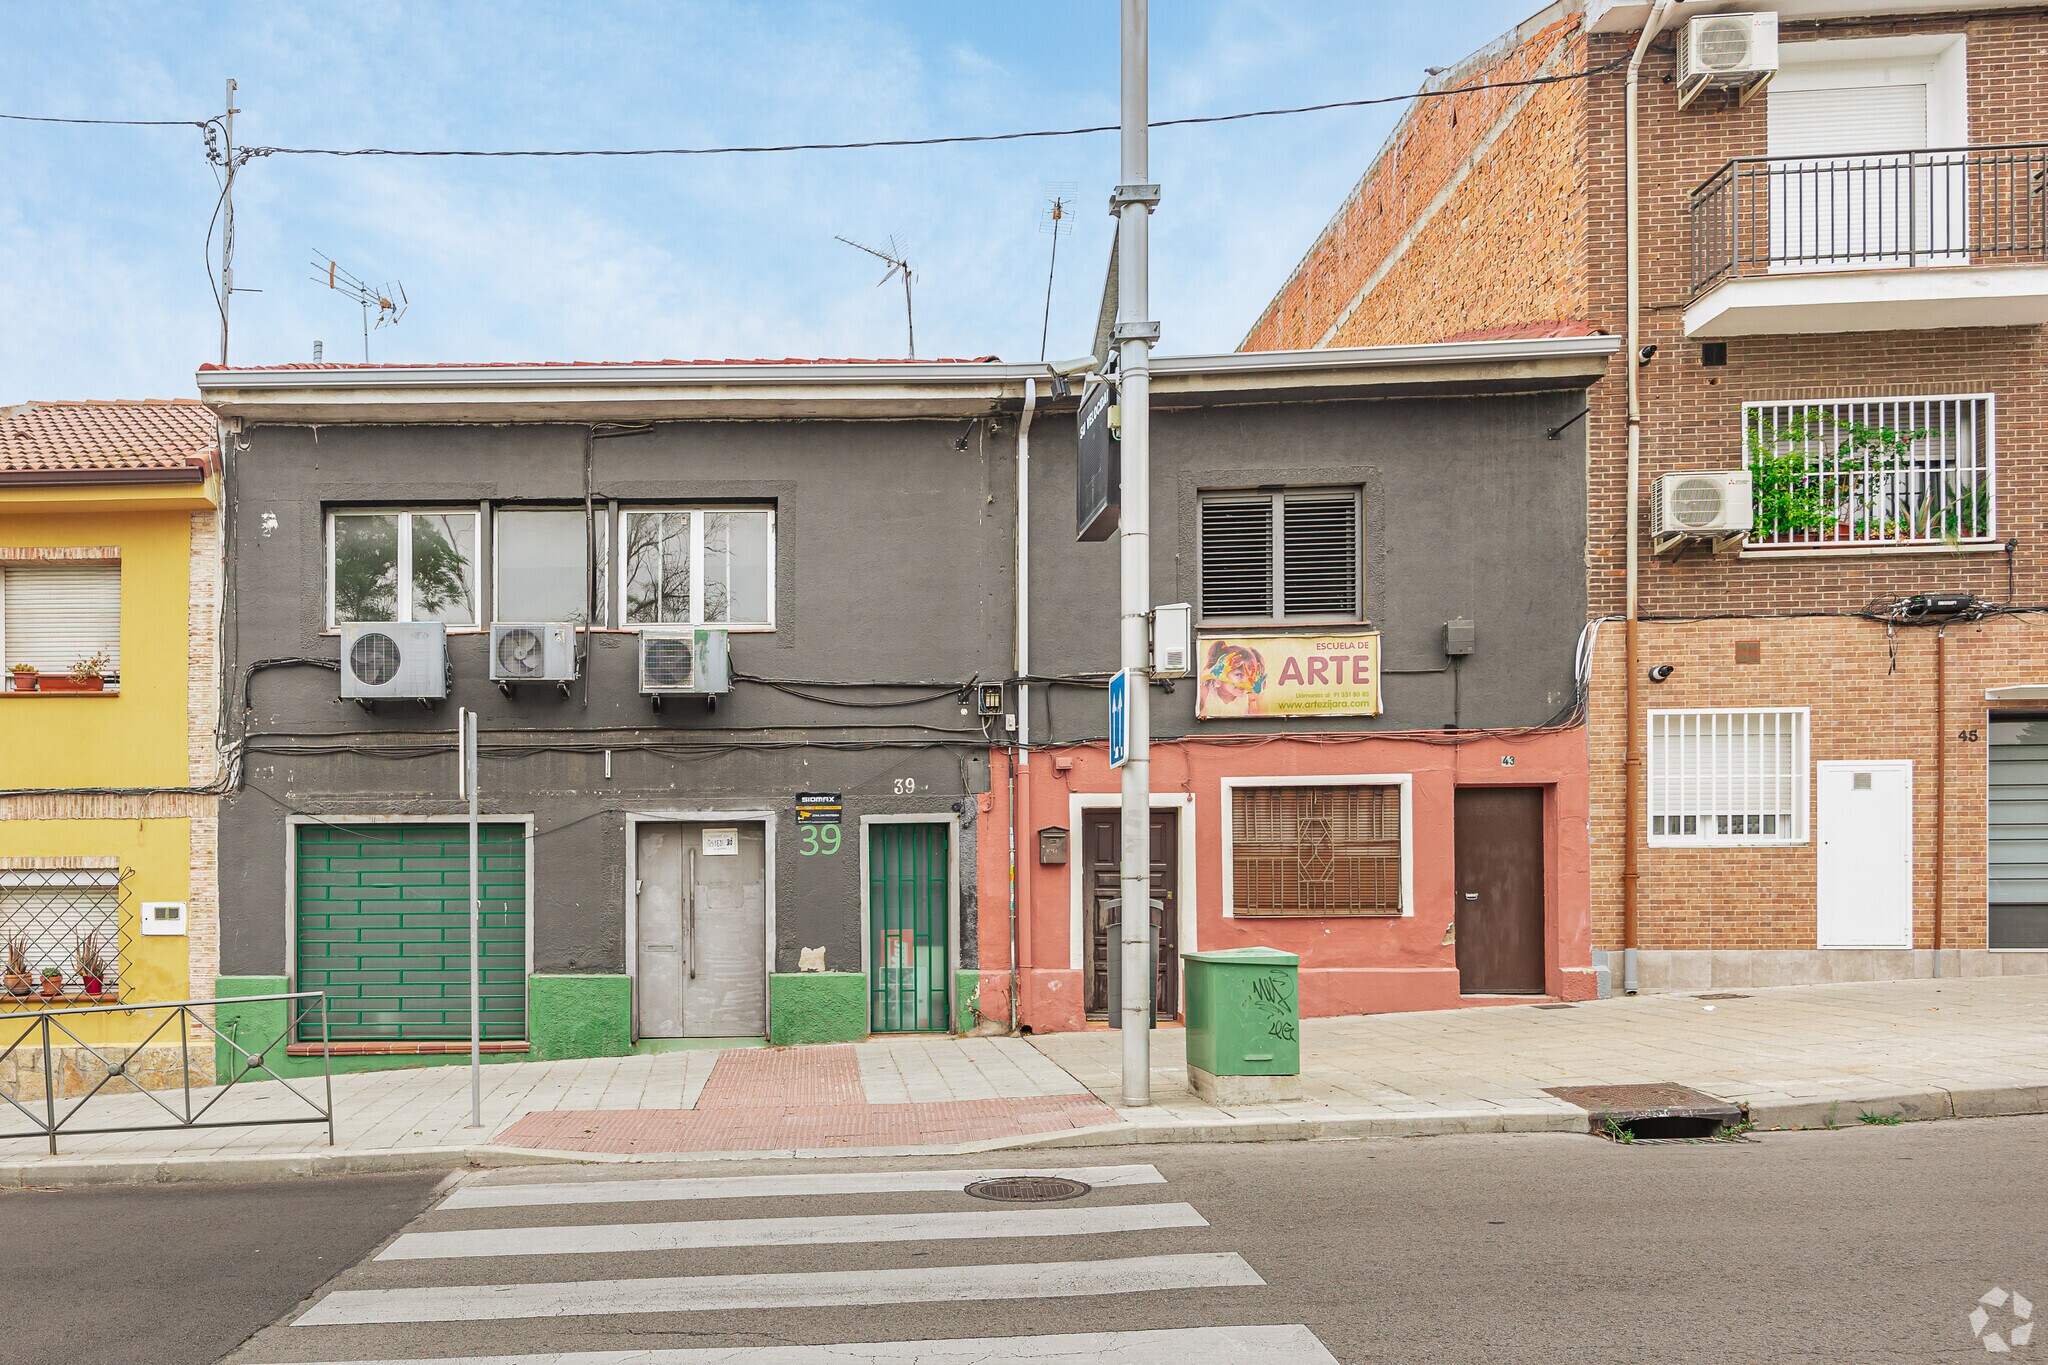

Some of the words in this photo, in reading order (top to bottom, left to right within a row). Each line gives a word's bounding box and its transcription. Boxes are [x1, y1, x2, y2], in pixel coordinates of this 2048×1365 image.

[1316, 642, 1355, 650] ESCUELA
[1357, 641, 1369, 649] DE
[1278, 655, 1370, 686] ARTE
[1278, 700, 1370, 710] www.artezijara.com
[1958, 729, 1979, 743] 45
[1502, 755, 1515, 766] 43
[893, 777, 916, 795] 39
[800, 823, 842, 856] 39
